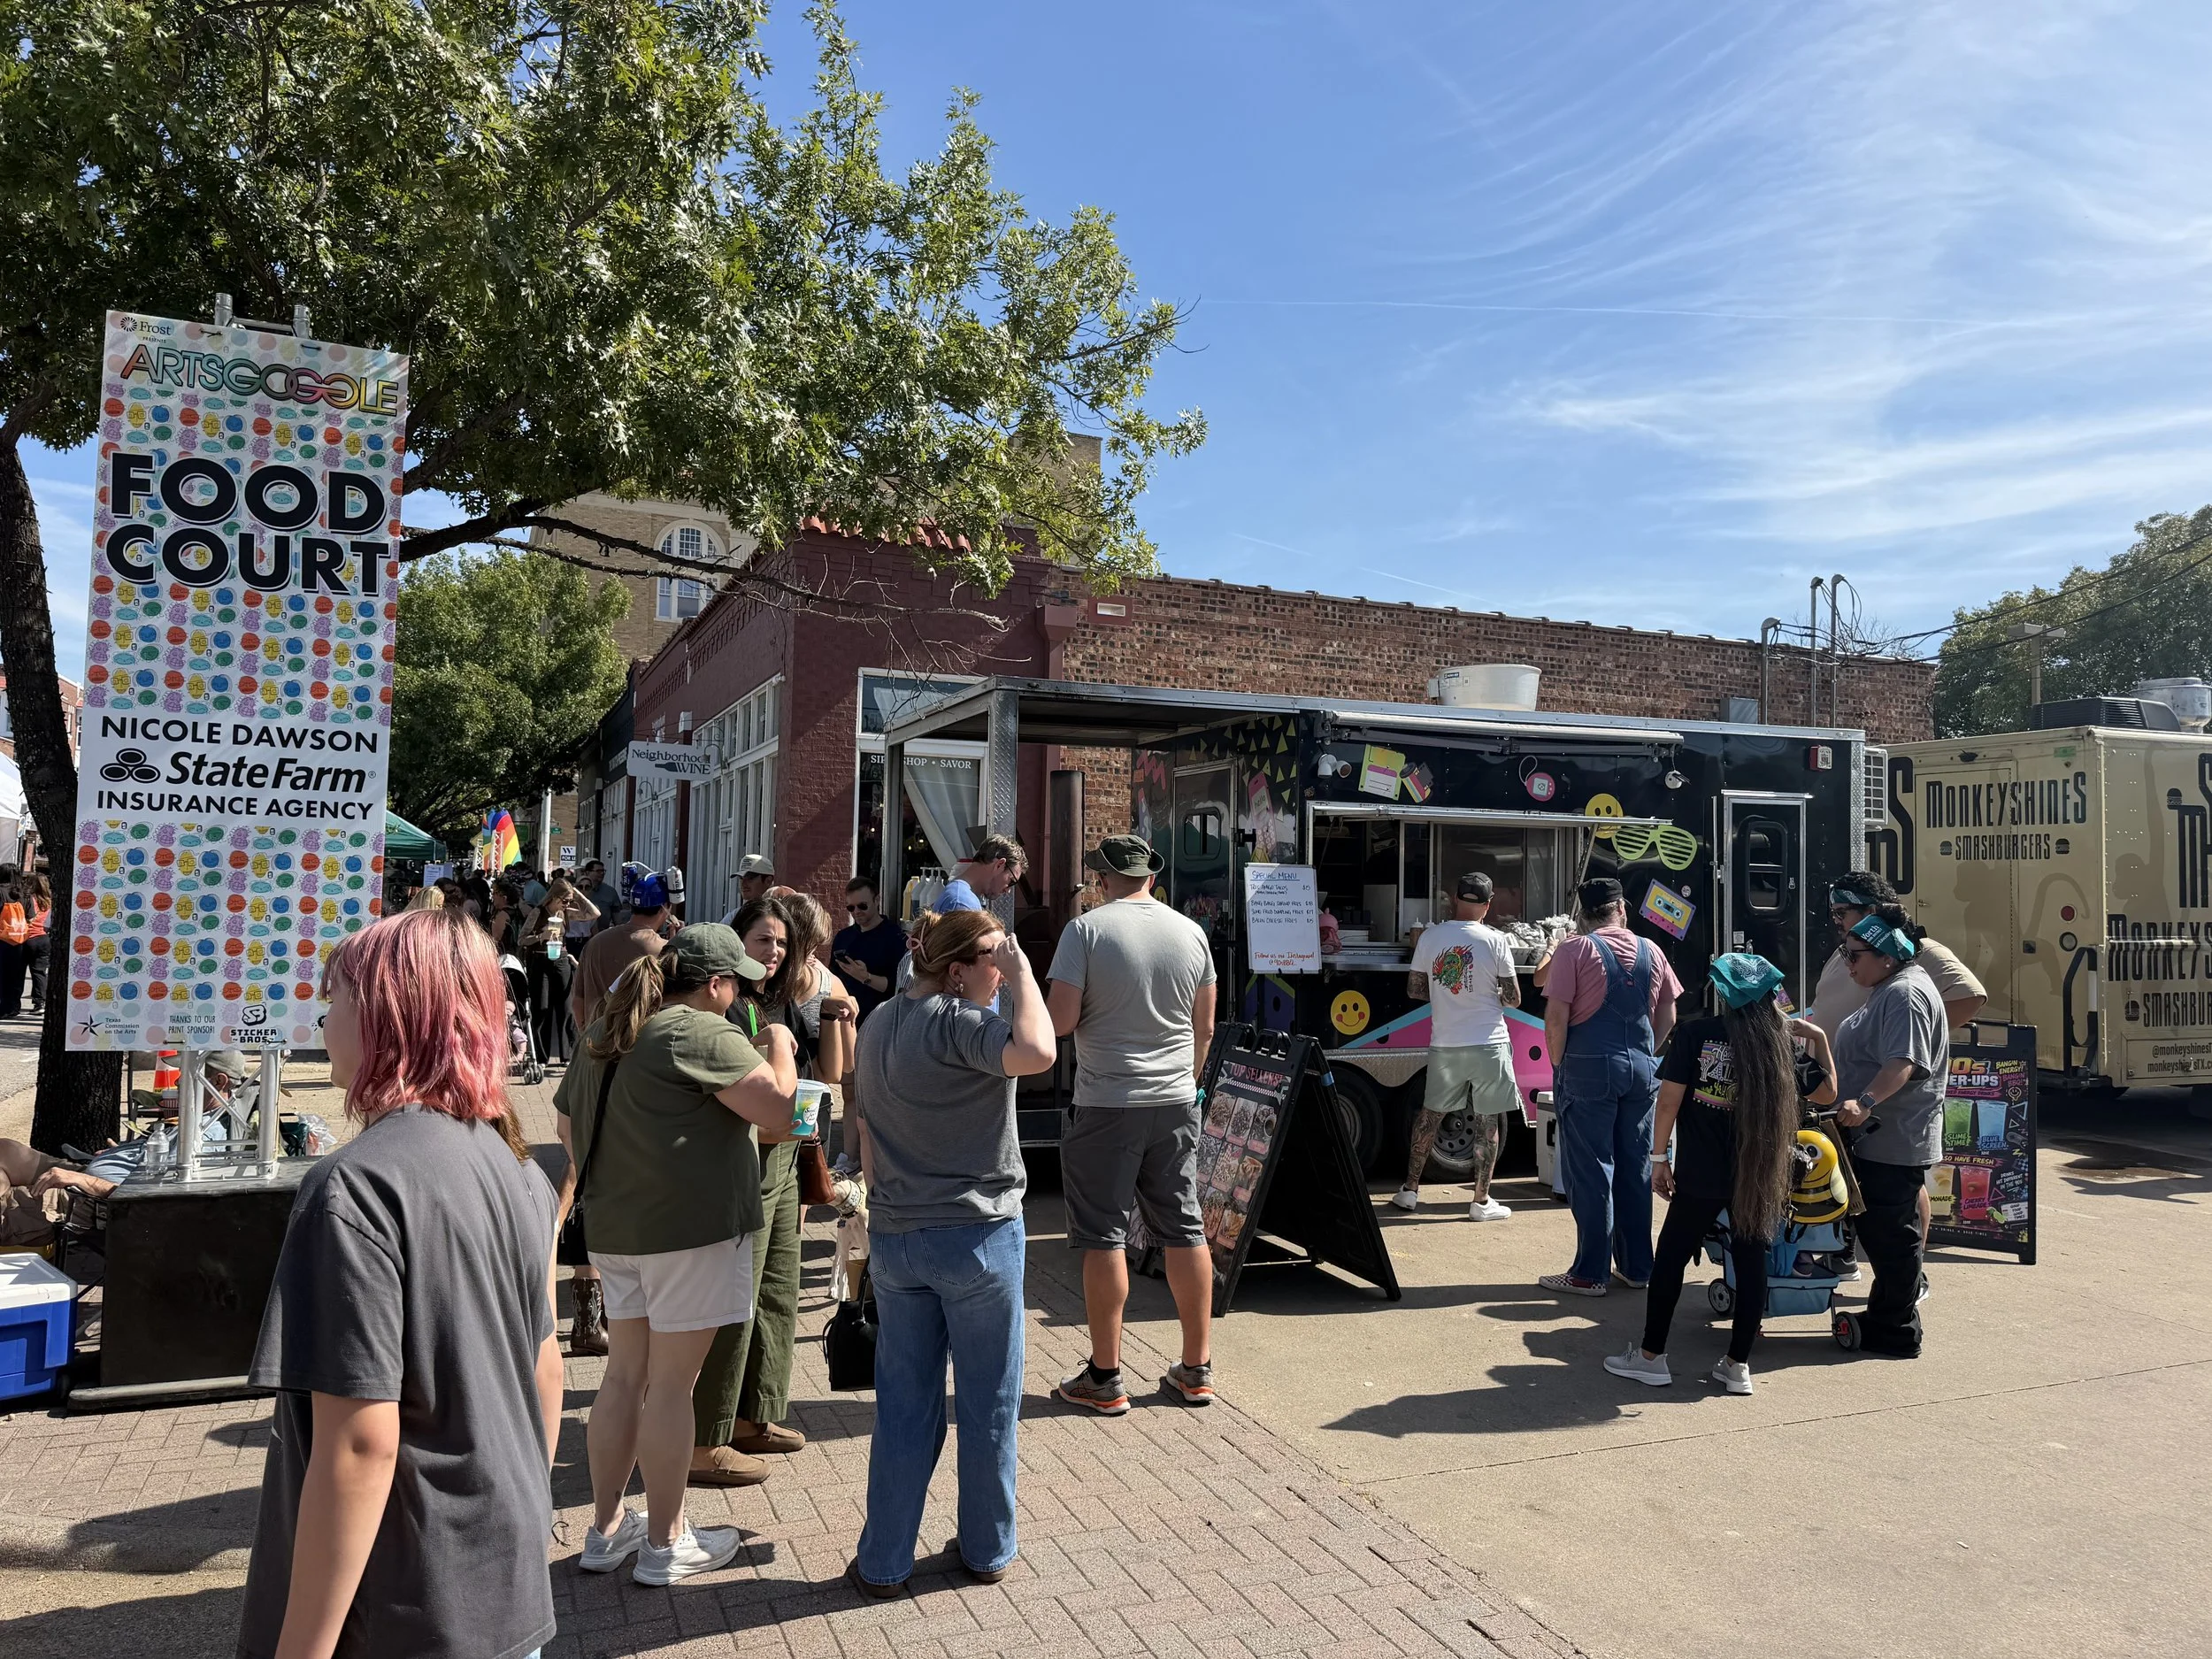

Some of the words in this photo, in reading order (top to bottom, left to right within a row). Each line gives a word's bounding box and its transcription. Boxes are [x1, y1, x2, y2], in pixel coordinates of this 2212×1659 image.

[140, 321, 171, 335] Frost
[111, 452, 387, 535] FOOD
[105, 524, 391, 597] COURT
[101, 715, 221, 744] NICOLE
[232, 724, 378, 753] DAWSON
[677, 762, 710, 774] WINE
[941, 759, 971, 769] SAVOR
[97, 790, 257, 816] INSURANCE
[265, 798, 373, 820] AGENCY
[1926, 771, 2086, 828] MONKEYSHINES
[1955, 833, 2050, 861] SMASHBURGERS
[1252, 871, 1276, 879] SPECIAL
